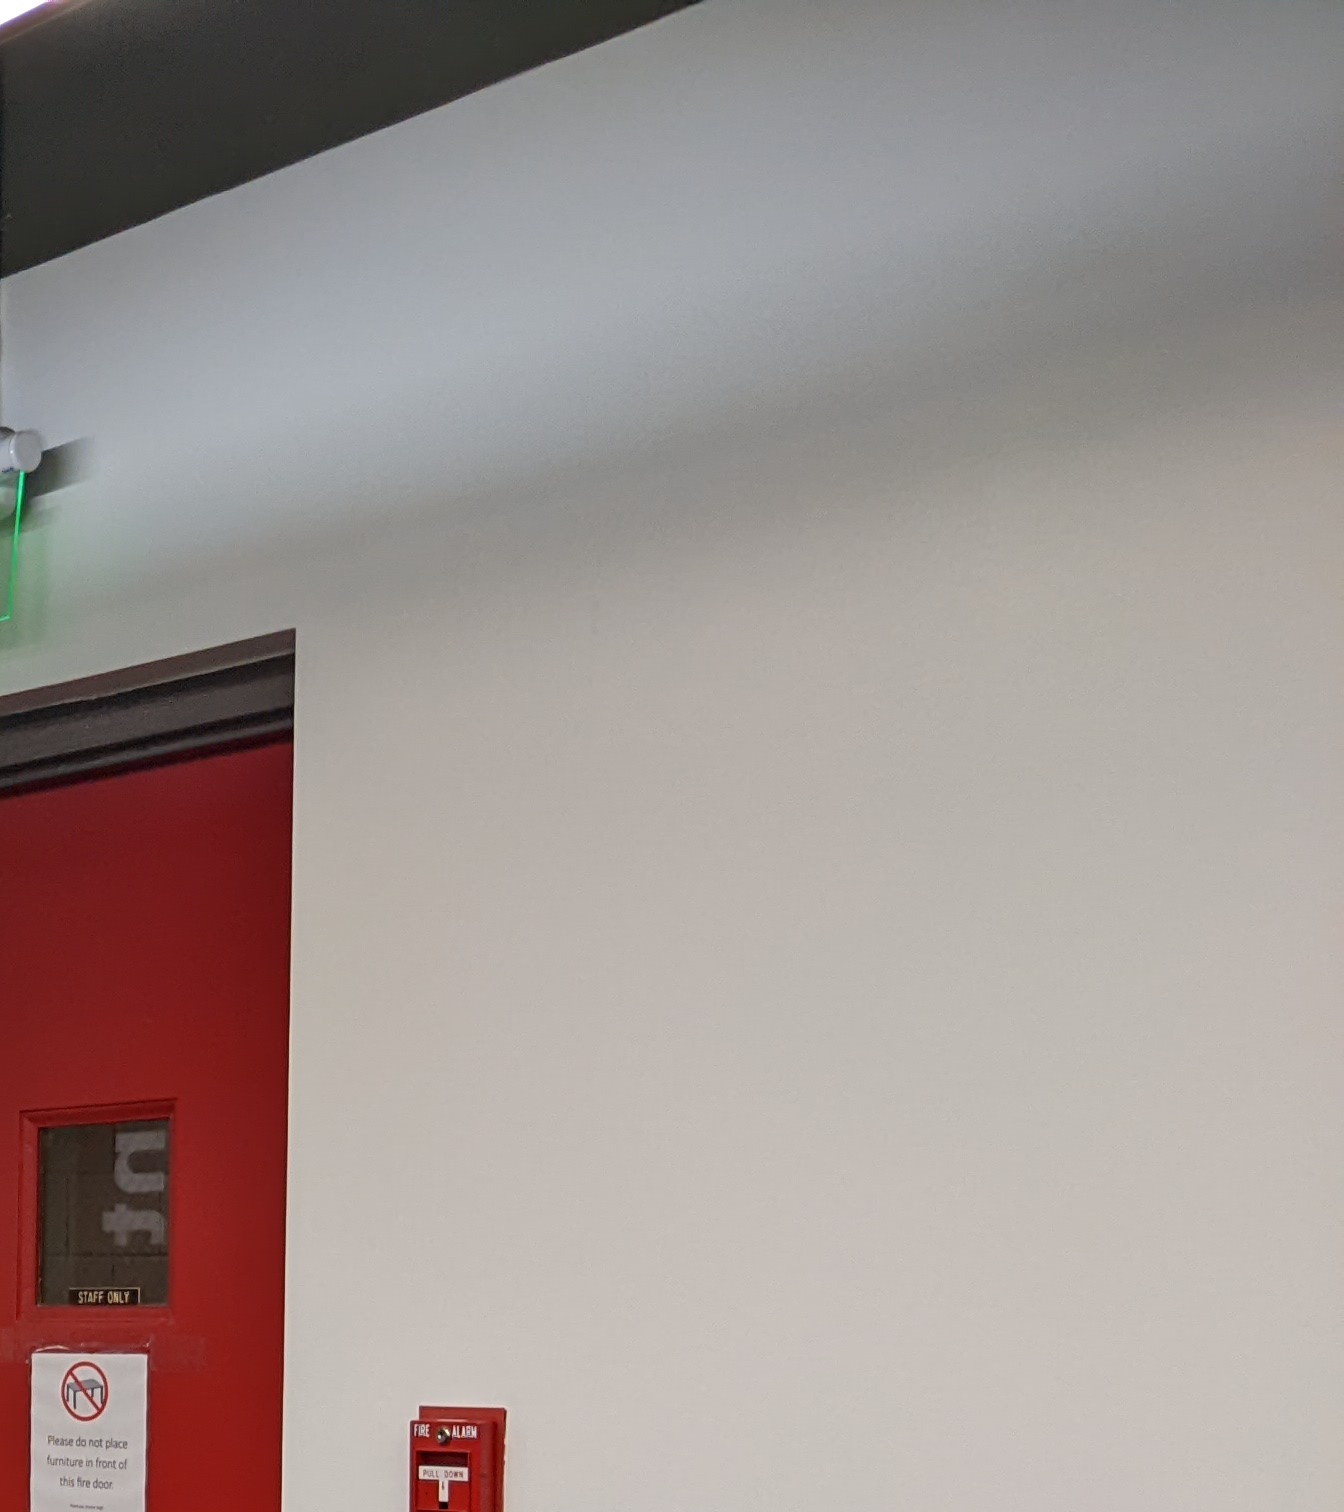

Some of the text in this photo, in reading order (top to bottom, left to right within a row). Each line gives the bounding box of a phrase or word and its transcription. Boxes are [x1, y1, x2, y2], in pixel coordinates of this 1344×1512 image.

[78, 1290, 130, 1304] STAFF ONLY
[414, 1424, 477, 1439] FIRE ALARM
[47, 1435, 128, 1450] Please do not place
[46, 1454, 127, 1470] furniture in front of
[423, 1469, 464, 1479] PULL DOWN
[59, 1476, 74, 1487] this
[77, 1476, 91, 1488] fire
